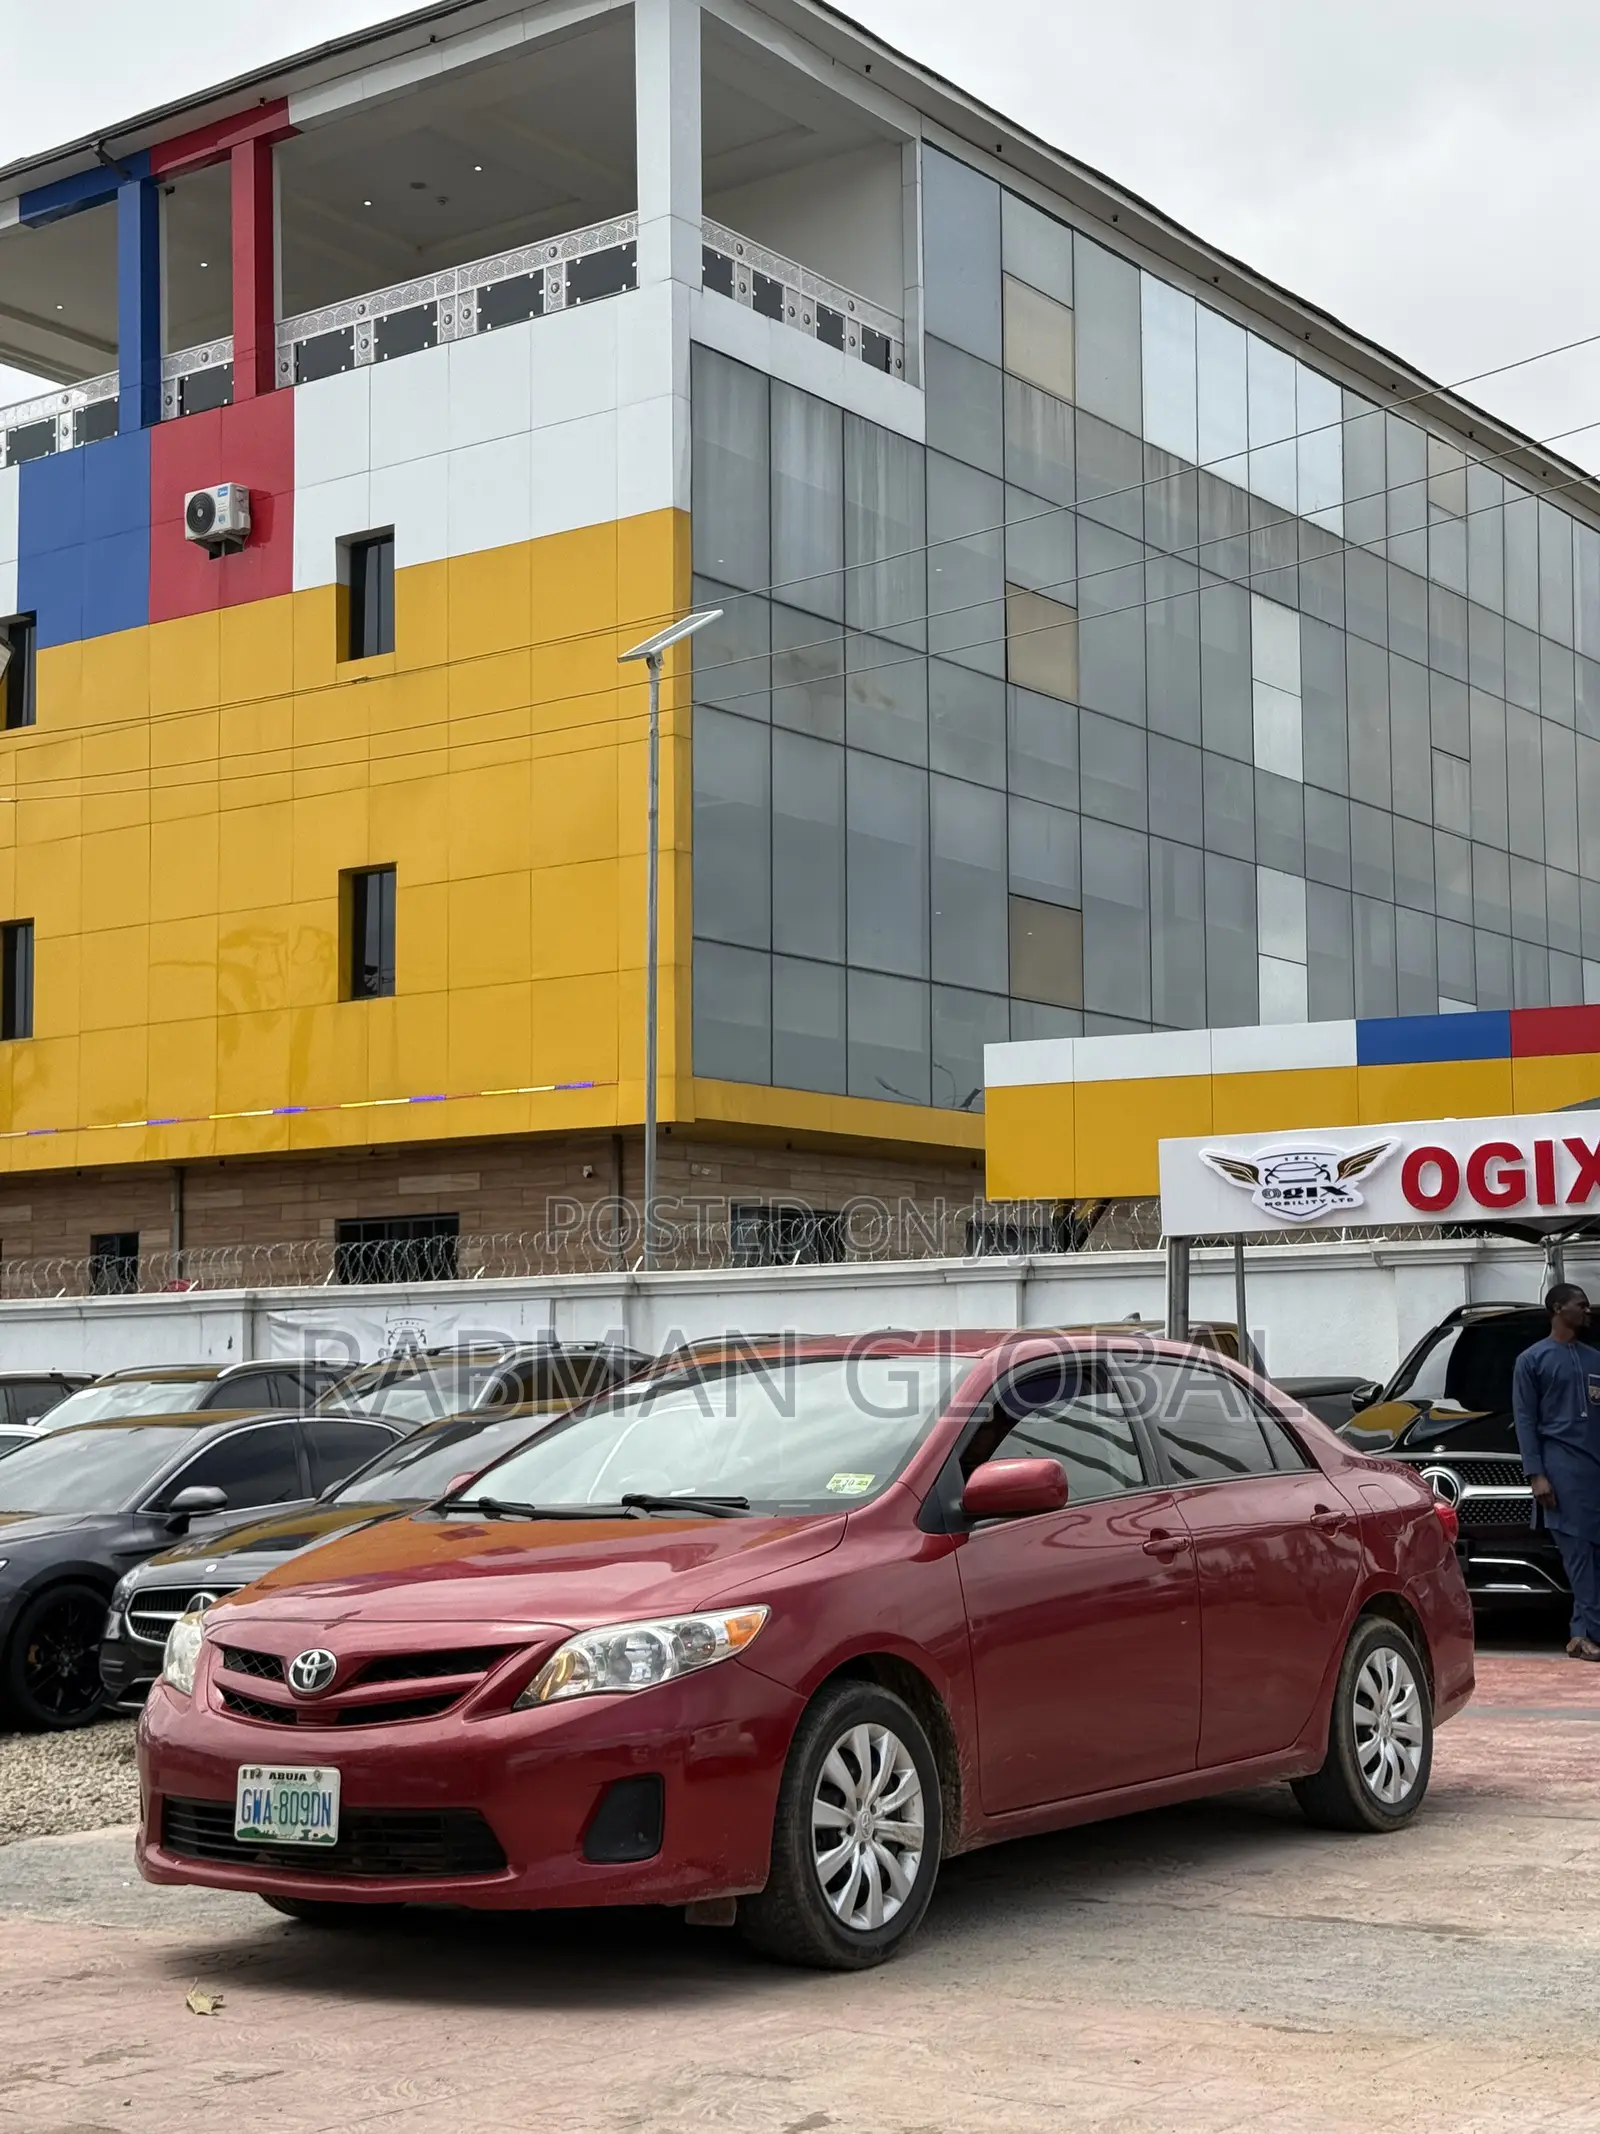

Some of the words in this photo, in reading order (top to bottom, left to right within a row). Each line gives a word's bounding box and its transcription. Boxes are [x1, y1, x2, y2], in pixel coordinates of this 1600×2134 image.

[1401, 1136, 1600, 1212] OGIX
[1265, 1199, 1327, 1207] MOBILITY
[268, 1771, 308, 1782] ABUJA
